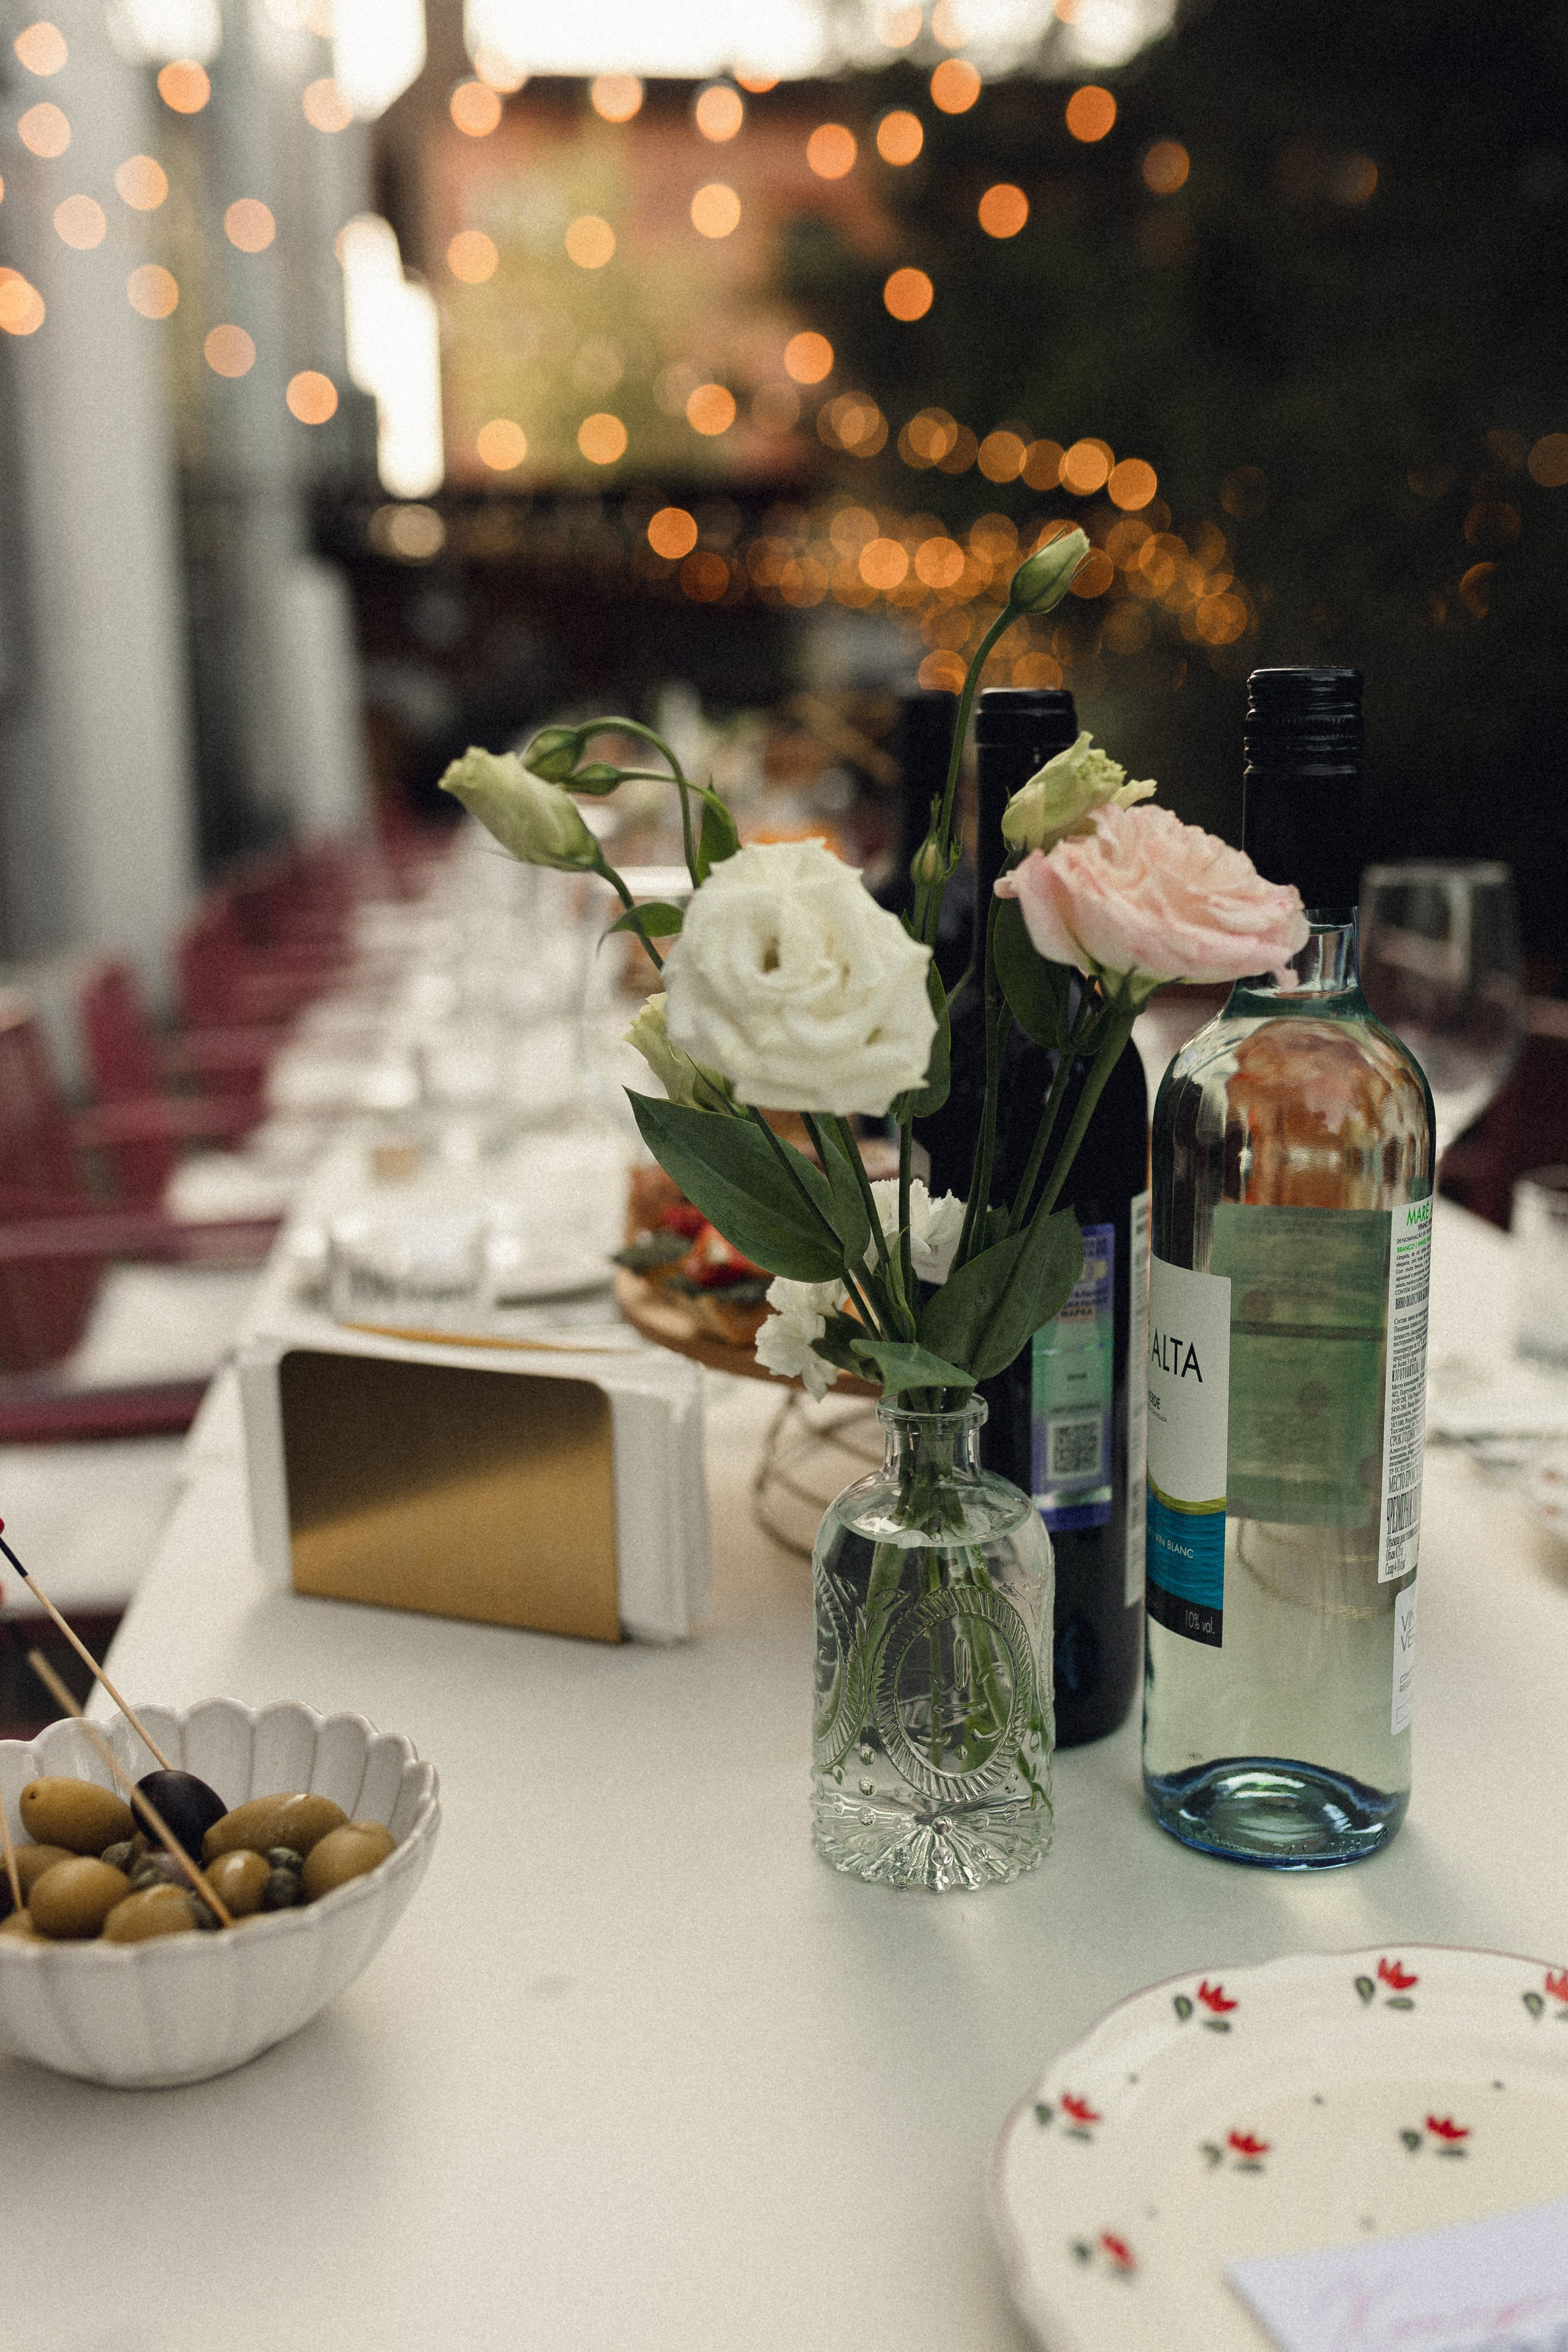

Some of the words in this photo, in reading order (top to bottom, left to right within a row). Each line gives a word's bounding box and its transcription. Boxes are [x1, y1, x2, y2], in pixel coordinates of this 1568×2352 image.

[1406, 1199, 1429, 1226] MARÉ
[1397, 1232, 1422, 1244] DENOMINAÇÃO
[1397, 1243, 1415, 1253] BRANCO
[1395, 1286, 1411, 1295] CONTÉM
[1395, 1296, 1406, 1310] ВИНО
[1394, 1324, 1409, 1333] Пищевая
[1393, 1332, 1410, 1341] ценность
[1393, 1336, 1415, 1348] постороннего
[1152, 1327, 1203, 1383] ALTA
[1393, 1344, 1413, 1355] температуре
[1393, 1351, 1411, 1363] продукцию
[1397, 1360, 1407, 1368] более
[1390, 1420, 1404, 1429] 385100,
[1390, 1433, 1402, 1447] СРОК
[1389, 1446, 1407, 1455] Алкоголь
[1389, 1472, 1405, 1493] МЕСТО
[1155, 1532, 1165, 1547] VIN
[1167, 1540, 1194, 1559] BLANC
[1185, 1610, 1200, 1630] 10%
[1202, 1616, 1215, 1634] vol.
